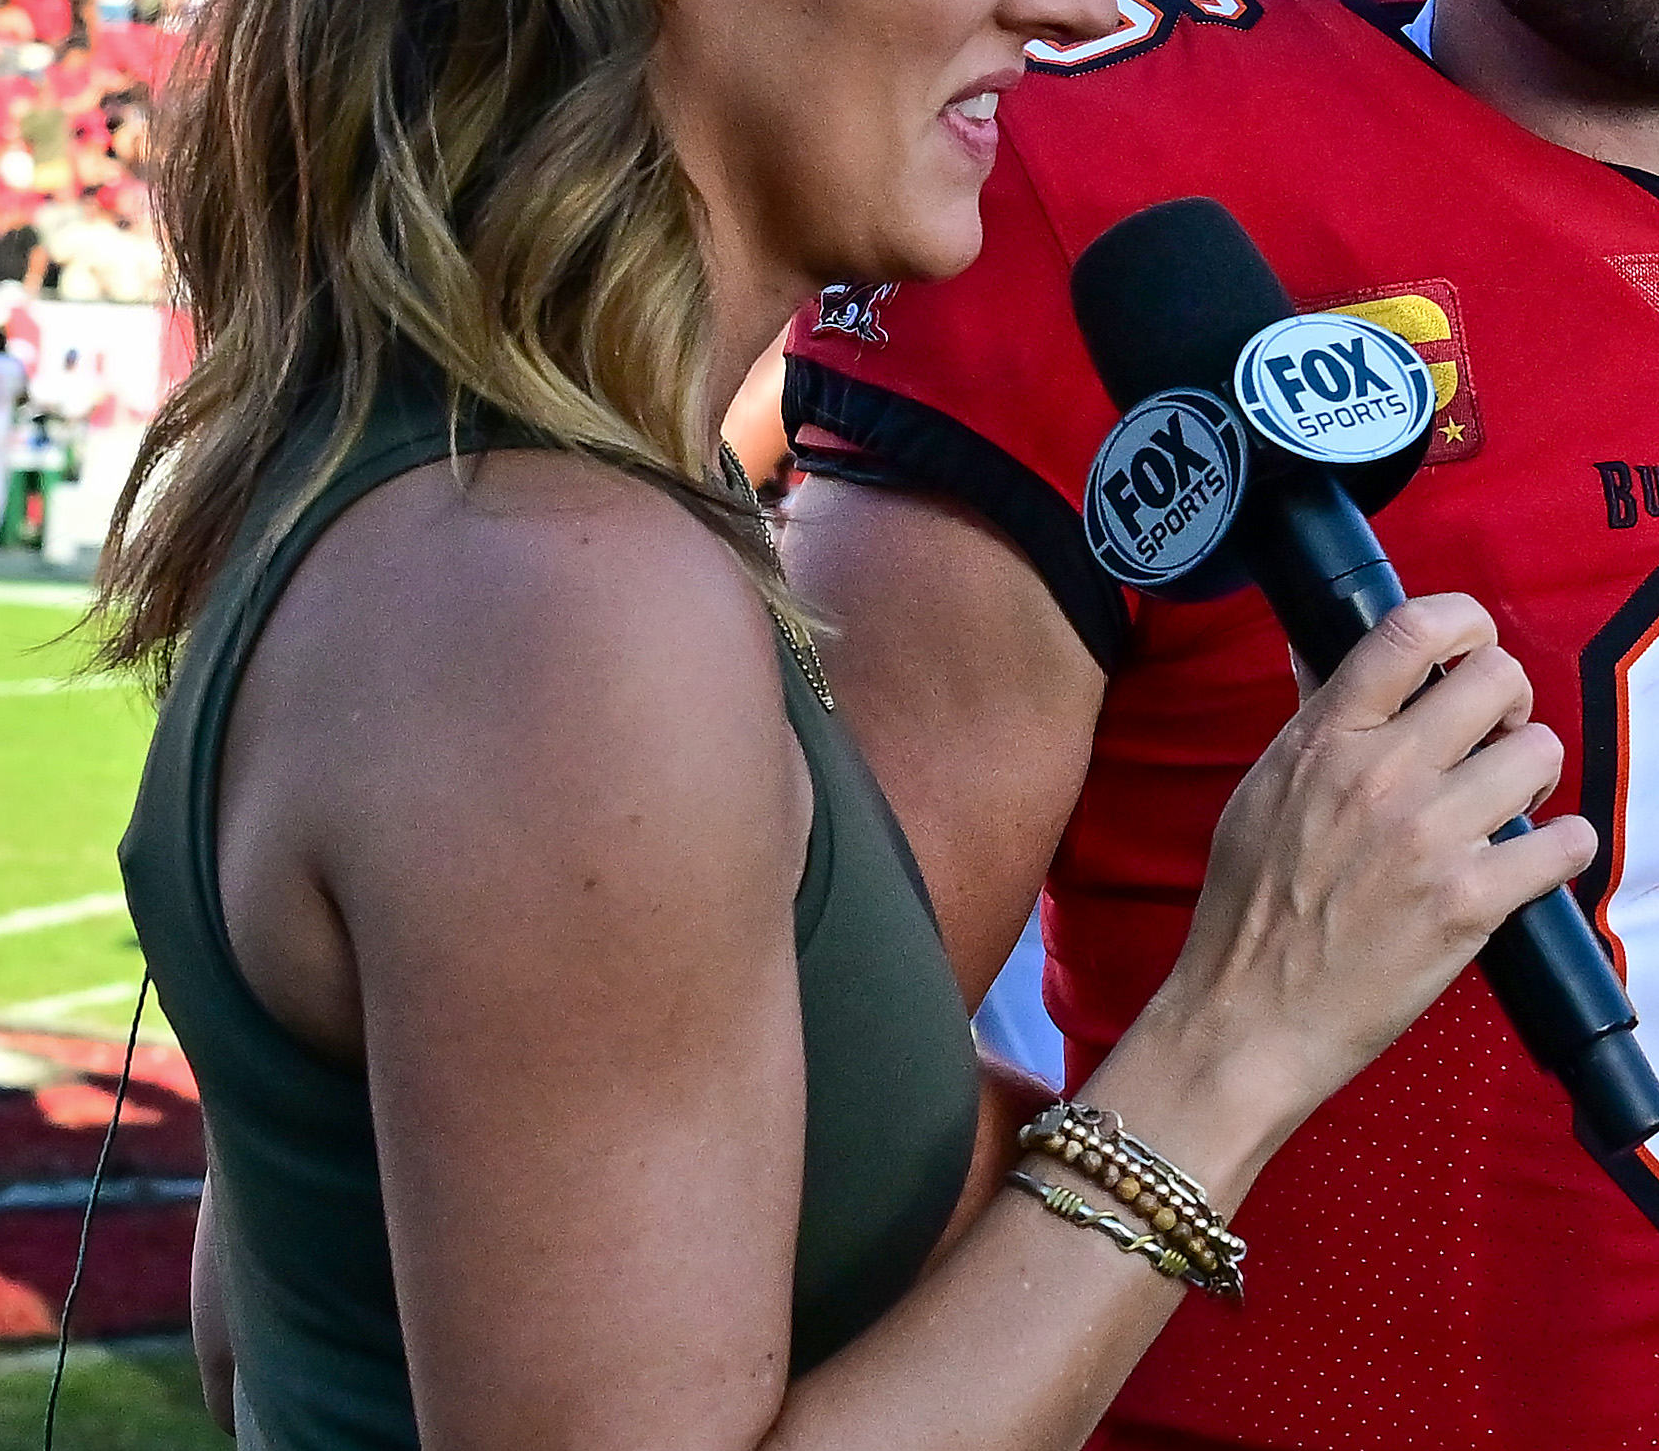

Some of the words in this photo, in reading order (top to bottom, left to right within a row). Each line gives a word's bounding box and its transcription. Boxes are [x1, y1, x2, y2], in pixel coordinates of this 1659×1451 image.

[1263, 337, 1394, 414] FOX
[1296, 393, 1408, 438] SPORTS
[1102, 411, 1214, 542] FOX
[1134, 465, 1227, 565] SPORTS
